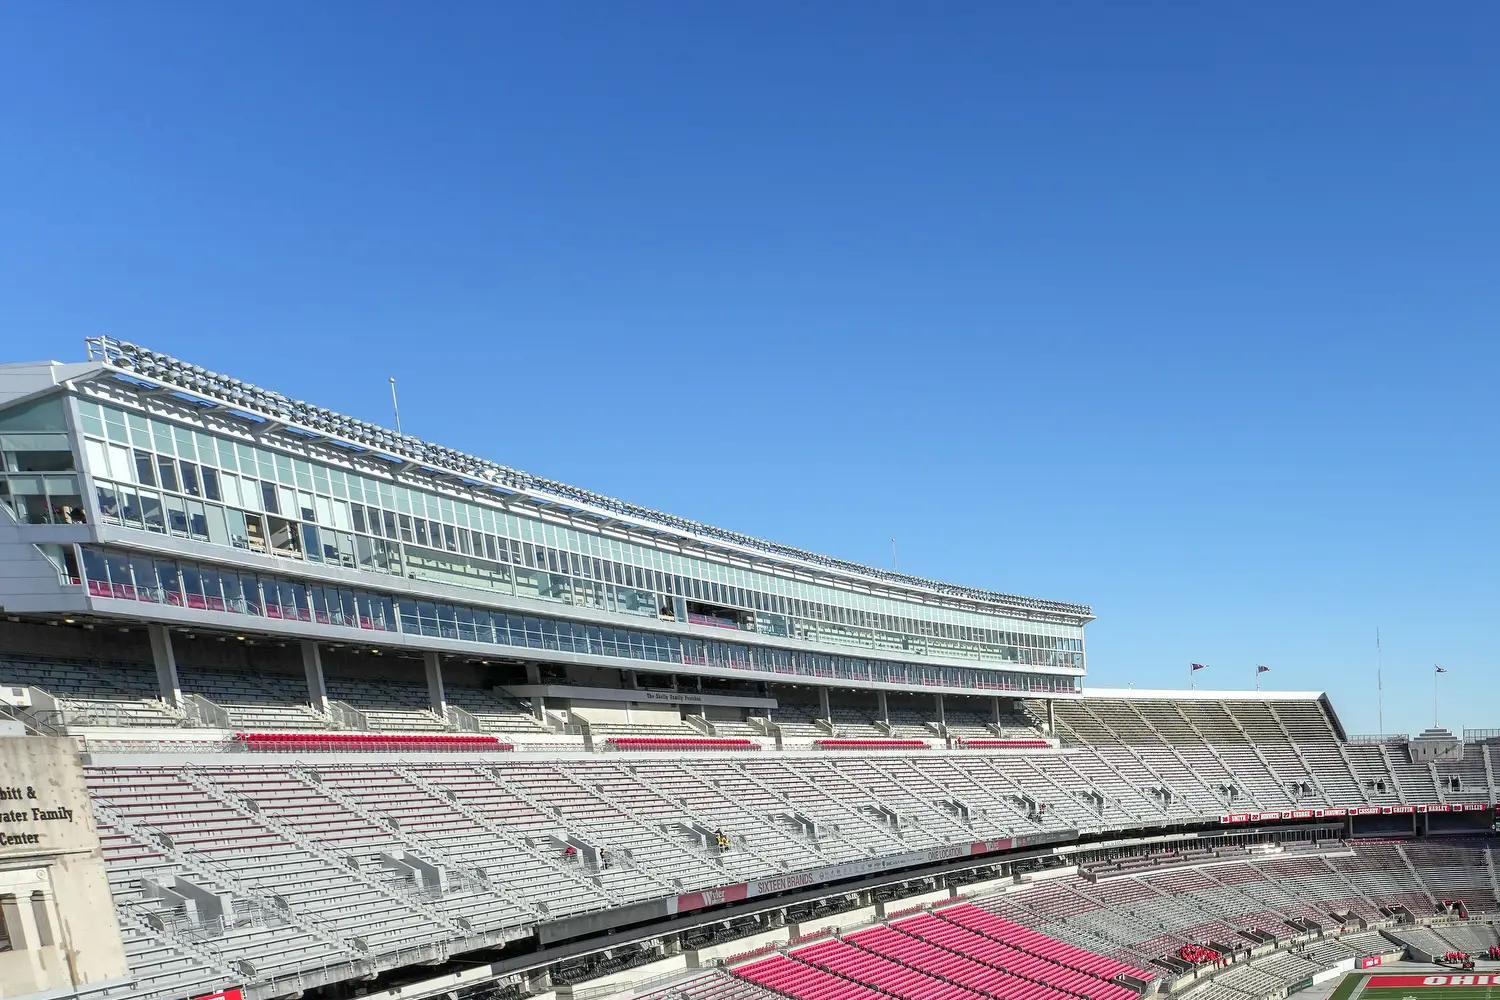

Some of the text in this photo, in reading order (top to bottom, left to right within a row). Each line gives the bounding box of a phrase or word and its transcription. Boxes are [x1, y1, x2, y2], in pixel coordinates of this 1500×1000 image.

[27, 786, 37, 799] &
[31, 807, 73, 822] Family
[0, 832, 39, 846] Center
[928, 850, 939, 861] ONE
[758, 873, 814, 893] SIXTEEN BRANDS.
